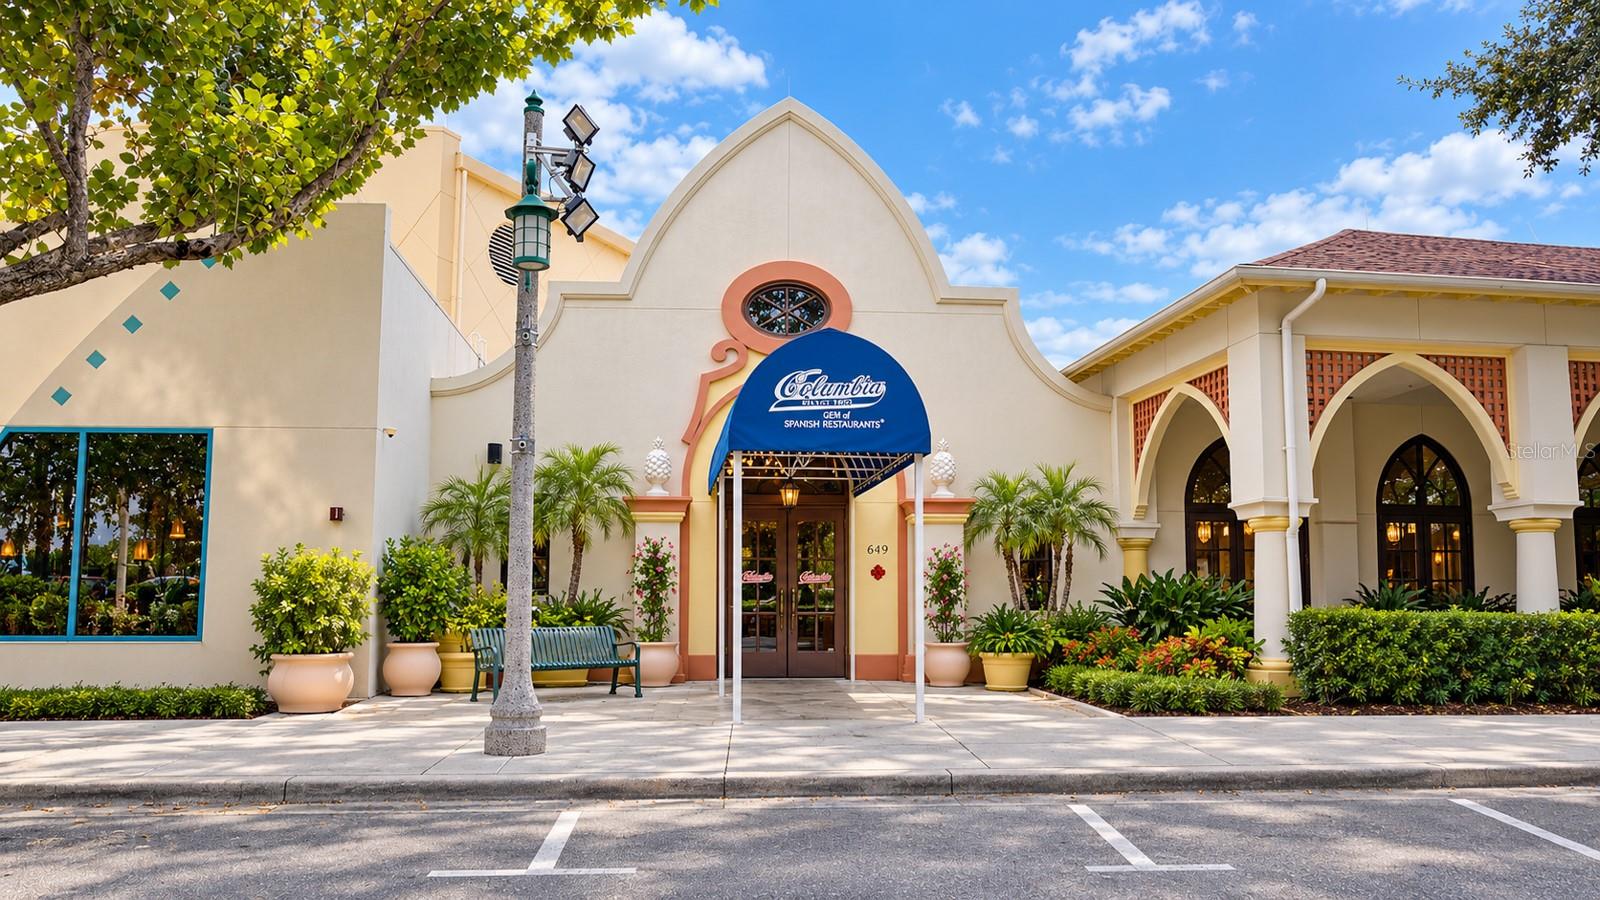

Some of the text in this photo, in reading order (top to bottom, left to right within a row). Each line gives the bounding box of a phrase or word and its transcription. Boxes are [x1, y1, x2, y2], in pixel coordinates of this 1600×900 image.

[774, 369, 886, 402] Columbia
[823, 411, 850, 419] GEM of
[784, 420, 820, 428] SPANISH
[867, 544, 888, 555] 649
